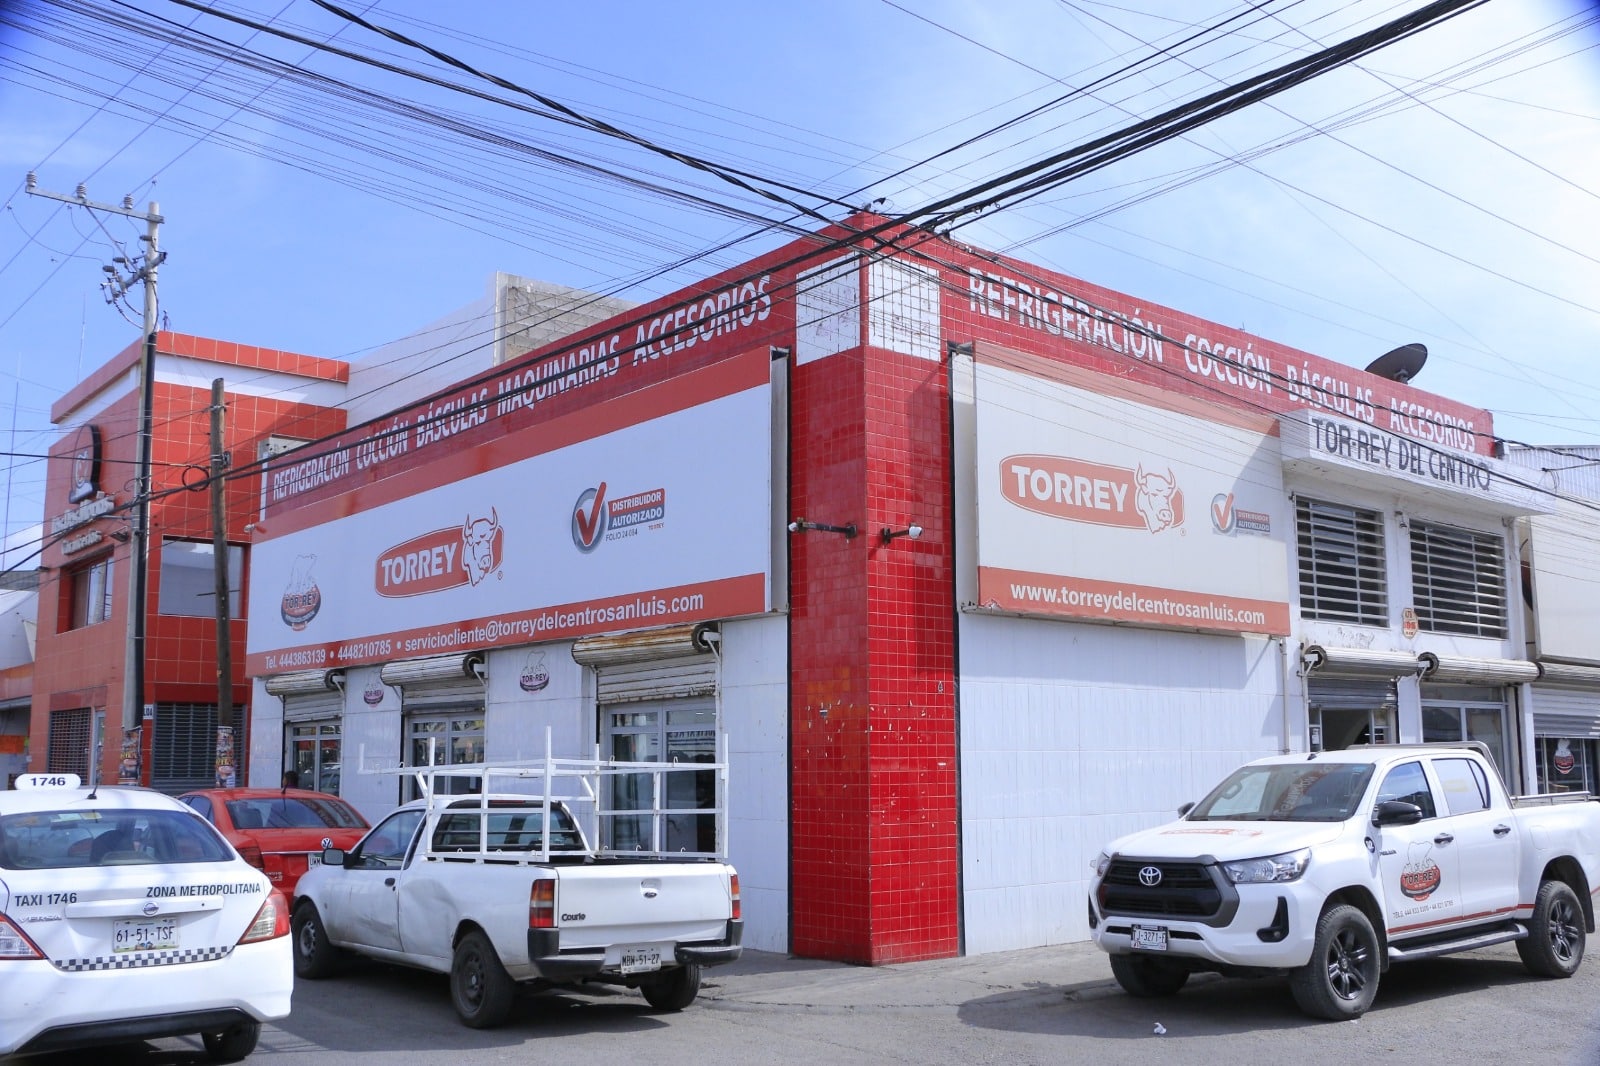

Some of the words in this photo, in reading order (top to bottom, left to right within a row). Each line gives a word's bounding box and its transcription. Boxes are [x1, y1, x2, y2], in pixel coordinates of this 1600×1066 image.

[968, 267, 1163, 363] REFRIGERACIÓN
[1184, 333, 1272, 394] COCCIÓN
[1287, 361, 1375, 425] BÁSCULAS
[1389, 397, 1476, 451] ACCESORIOS
[273, 441, 350, 501] REFRIGERACIÓN
[356, 417, 408, 470] COCCIÓN
[416, 388, 488, 448] BÁSCULAS
[497, 335, 620, 417] MAQUINARIAS
[633, 275, 771, 367] ACCESORIOS
[1312, 418, 1393, 469] TOR-REY
[1399, 439, 1425, 476] DEL
[1428, 451, 1491, 491] CENTRO
[612, 491, 662, 512] DISTRIBUIDOR
[1011, 464, 1128, 513] TORREY
[612, 507, 662, 528] AUTORIZADO
[381, 542, 458, 587] TORREY
[1010, 583, 1265, 625] www.torreydelcentrosanluis.com
[265, 655, 278, 670] Tel.
[337, 639, 391, 661] 4448210785
[405, 592, 704, 652] serviciocliente@torreydelcentrosanluis.com
[30, 777, 66, 787] 1746
[146, 886, 177, 898] ZONA
[180, 882, 261, 897] METROPOLITANA
[1404, 871, 1437, 884] TOR-REY
[15, 895, 42, 907] TAXI
[47, 892, 77, 905] 1746
[116, 926, 175, 943] 61-51-TSF
